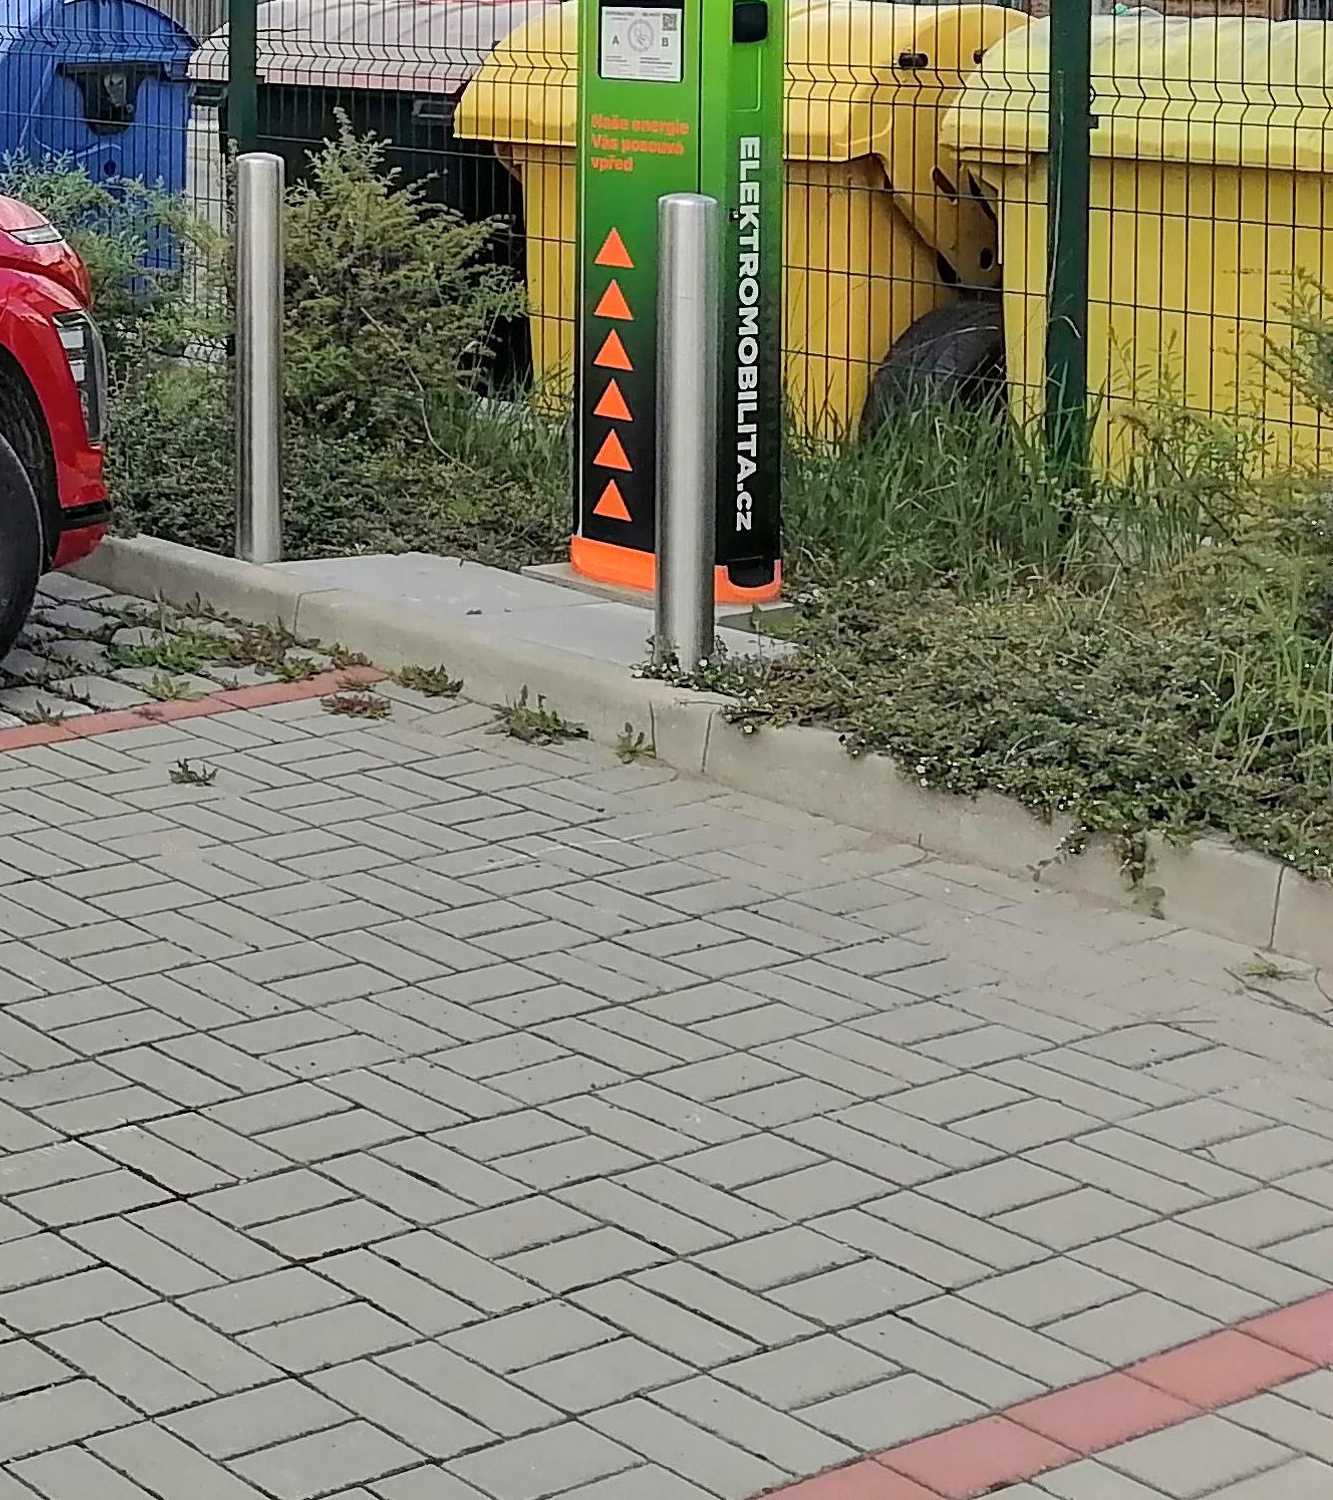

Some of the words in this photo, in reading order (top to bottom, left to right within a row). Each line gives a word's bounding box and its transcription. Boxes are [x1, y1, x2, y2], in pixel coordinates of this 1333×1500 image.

[612, 35, 620, 45] A
[661, 37, 669, 47] B
[632, 119, 689, 136] energie
